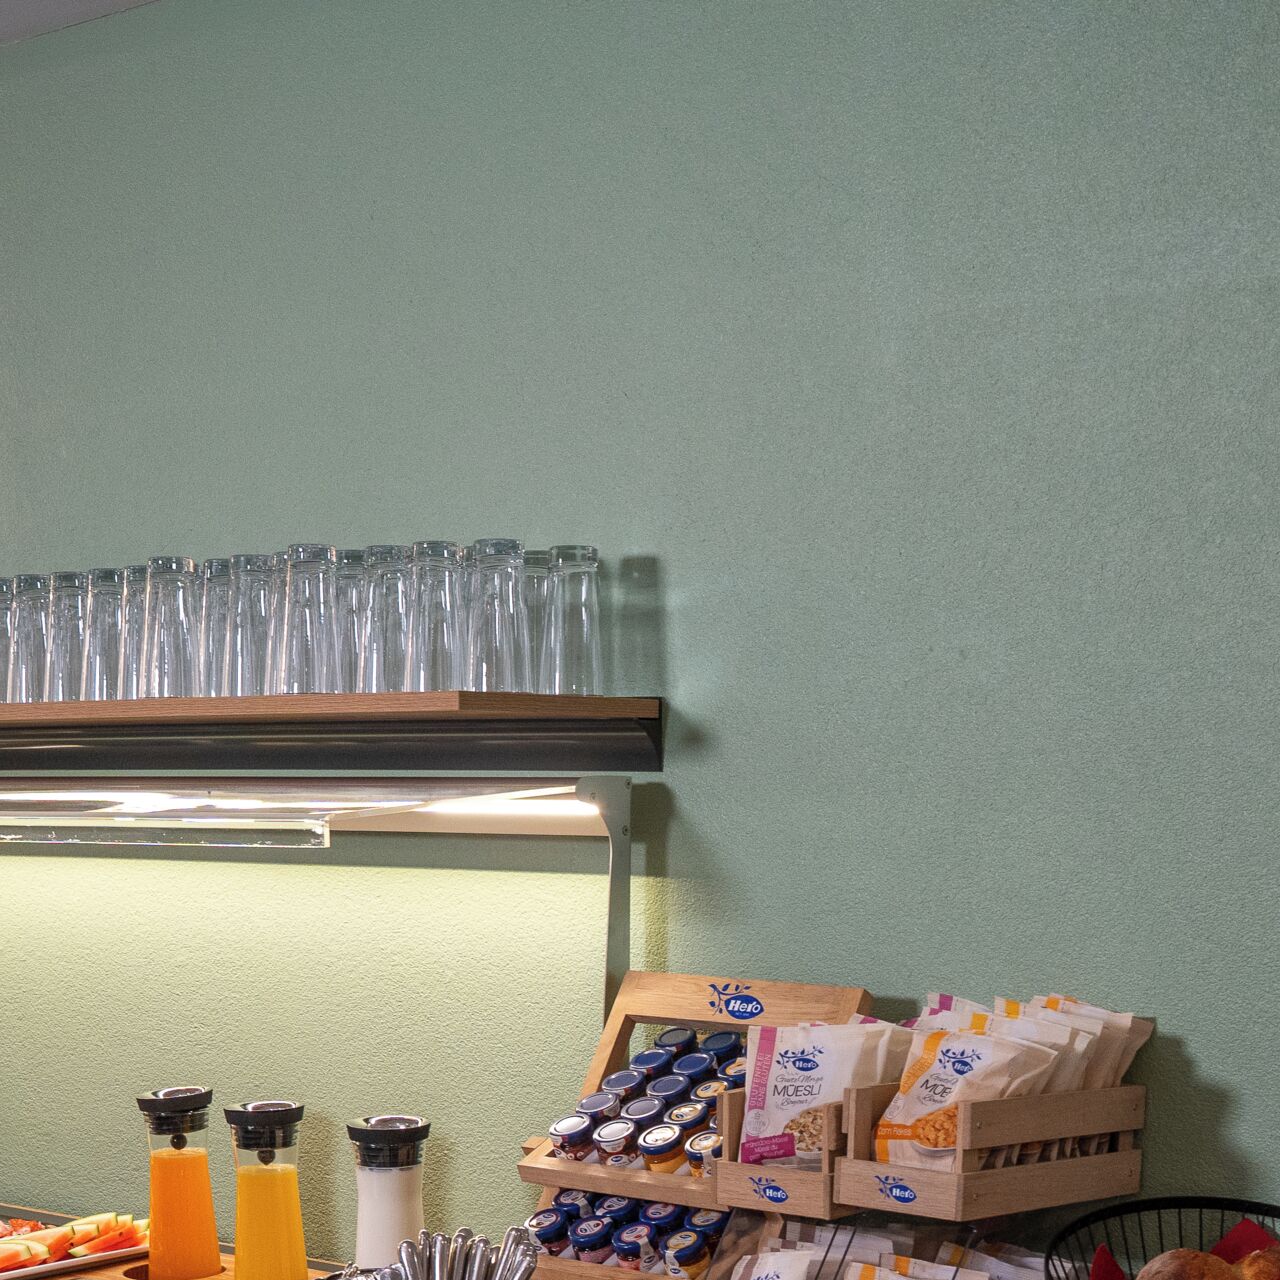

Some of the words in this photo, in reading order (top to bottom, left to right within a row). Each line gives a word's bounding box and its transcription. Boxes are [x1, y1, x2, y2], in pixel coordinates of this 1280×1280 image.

[728, 1000, 760, 1013] Hero
[795, 1060, 817, 1068] Hero
[773, 1083, 822, 1097] MÜESLI
[766, 1188, 787, 1199] Hero
[892, 1187, 915, 1199] Hero
